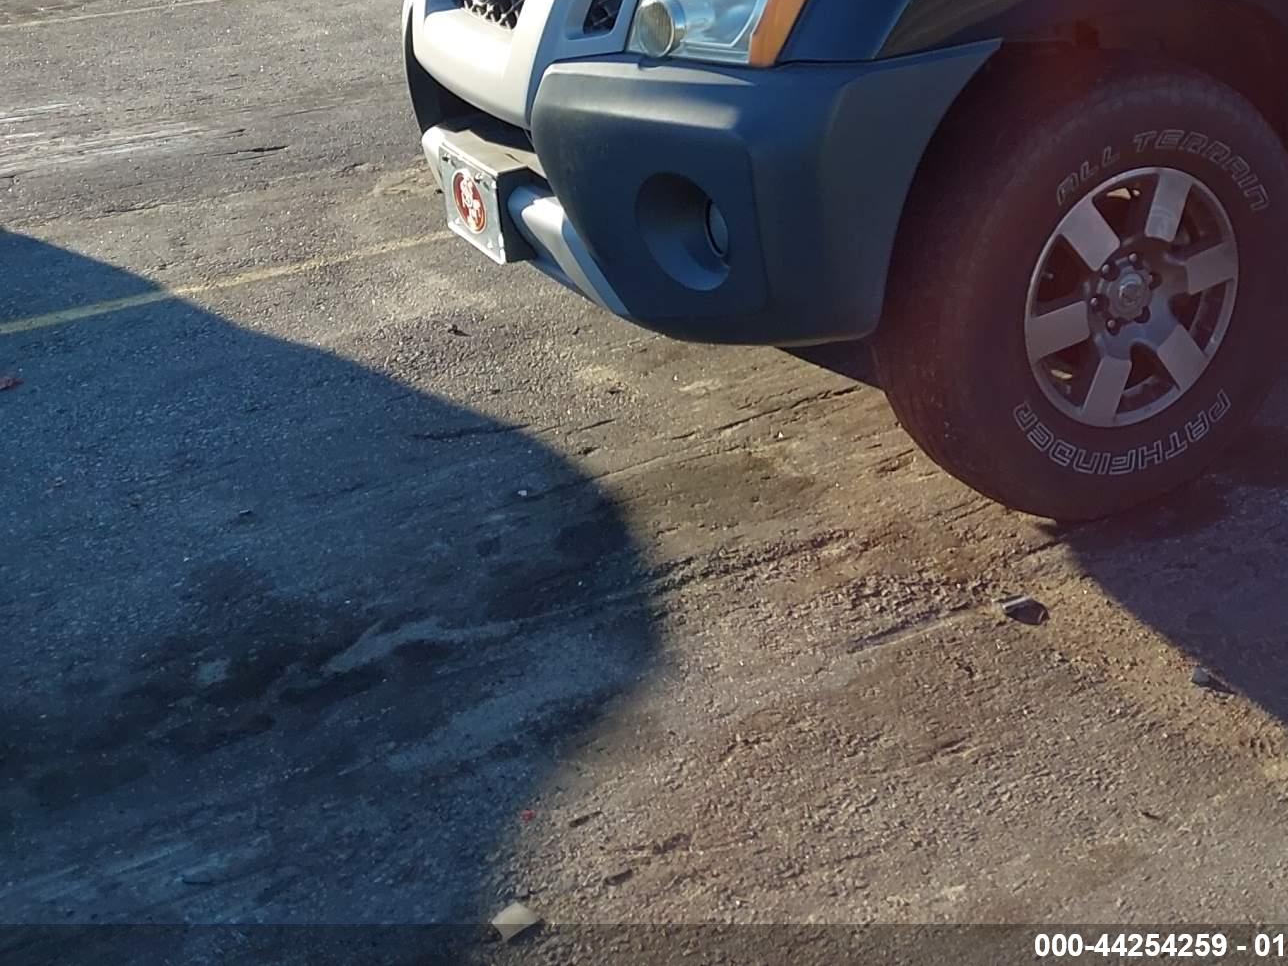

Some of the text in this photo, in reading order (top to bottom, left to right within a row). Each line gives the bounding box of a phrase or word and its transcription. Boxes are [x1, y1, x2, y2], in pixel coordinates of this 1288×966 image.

[1055, 129, 1271, 211] ALL TERRAIN
[1012, 388, 1232, 475] PATHFINDER
